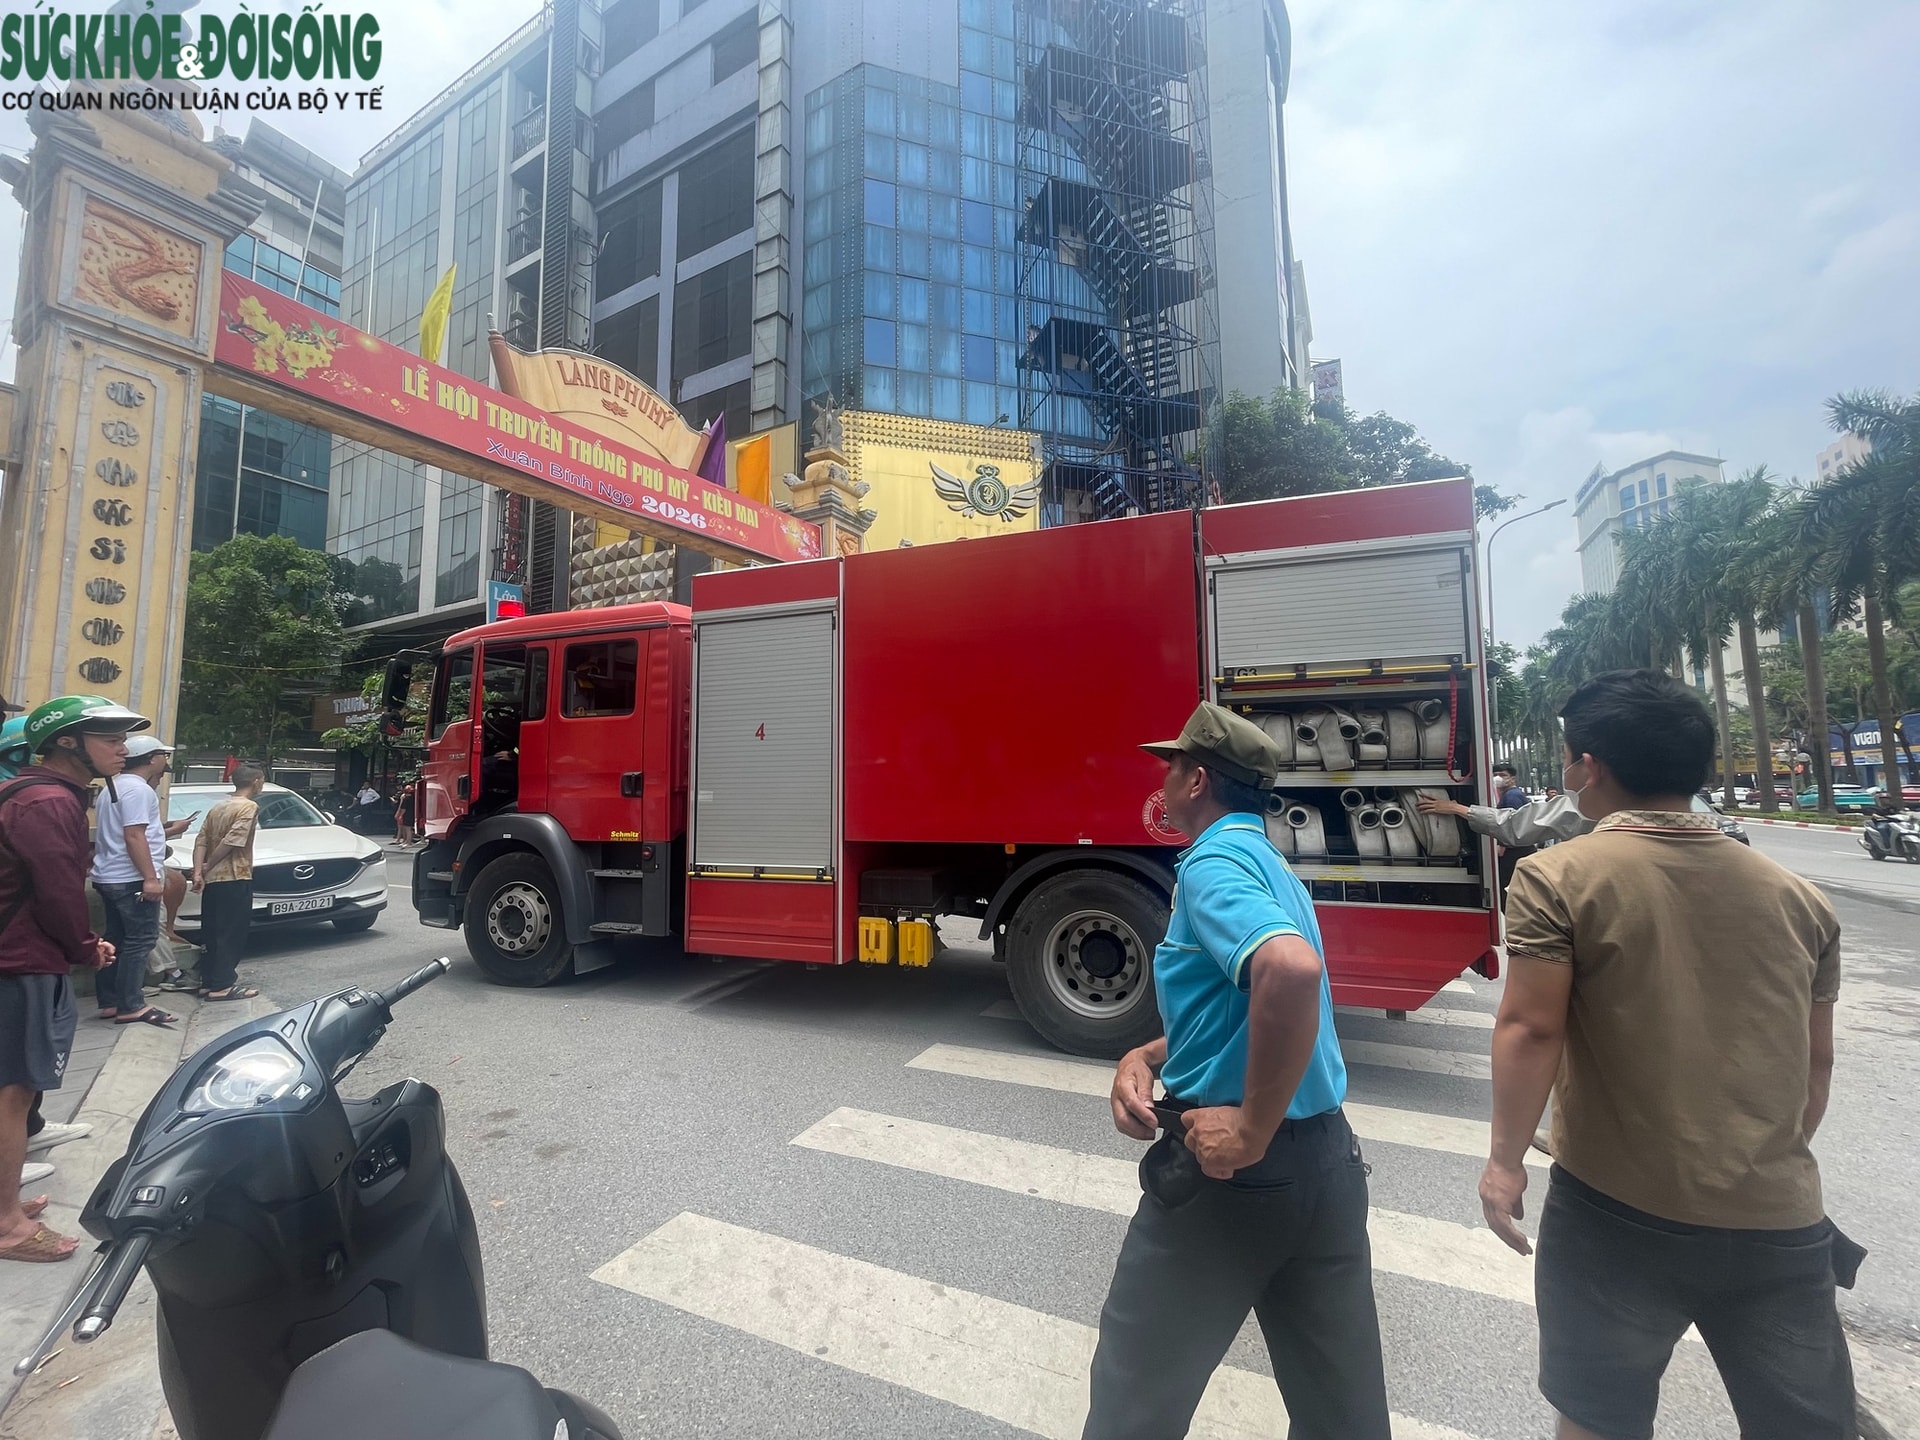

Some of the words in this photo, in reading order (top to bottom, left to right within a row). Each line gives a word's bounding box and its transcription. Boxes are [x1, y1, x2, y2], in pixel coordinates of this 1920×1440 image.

[556, 356, 611, 394] LÀNG
[402, 364, 429, 401] LỄ
[436, 379, 478, 420] HỘI
[484, 400, 562, 454] TRUYỀN
[567, 434, 627, 480] THỐNG
[631, 461, 663, 492] PHÚ
[667, 476, 689, 502] MỸ
[735, 502, 759, 529] MAI
[486, 438, 543, 473] Xuân
[549, 462, 593, 491] Bính
[598, 480, 634, 507] Ngọ
[641, 495, 708, 530] 2026
[30, 710, 64, 732] Grab
[755, 722, 766, 741] 4
[610, 830, 639, 838] Schmitz
